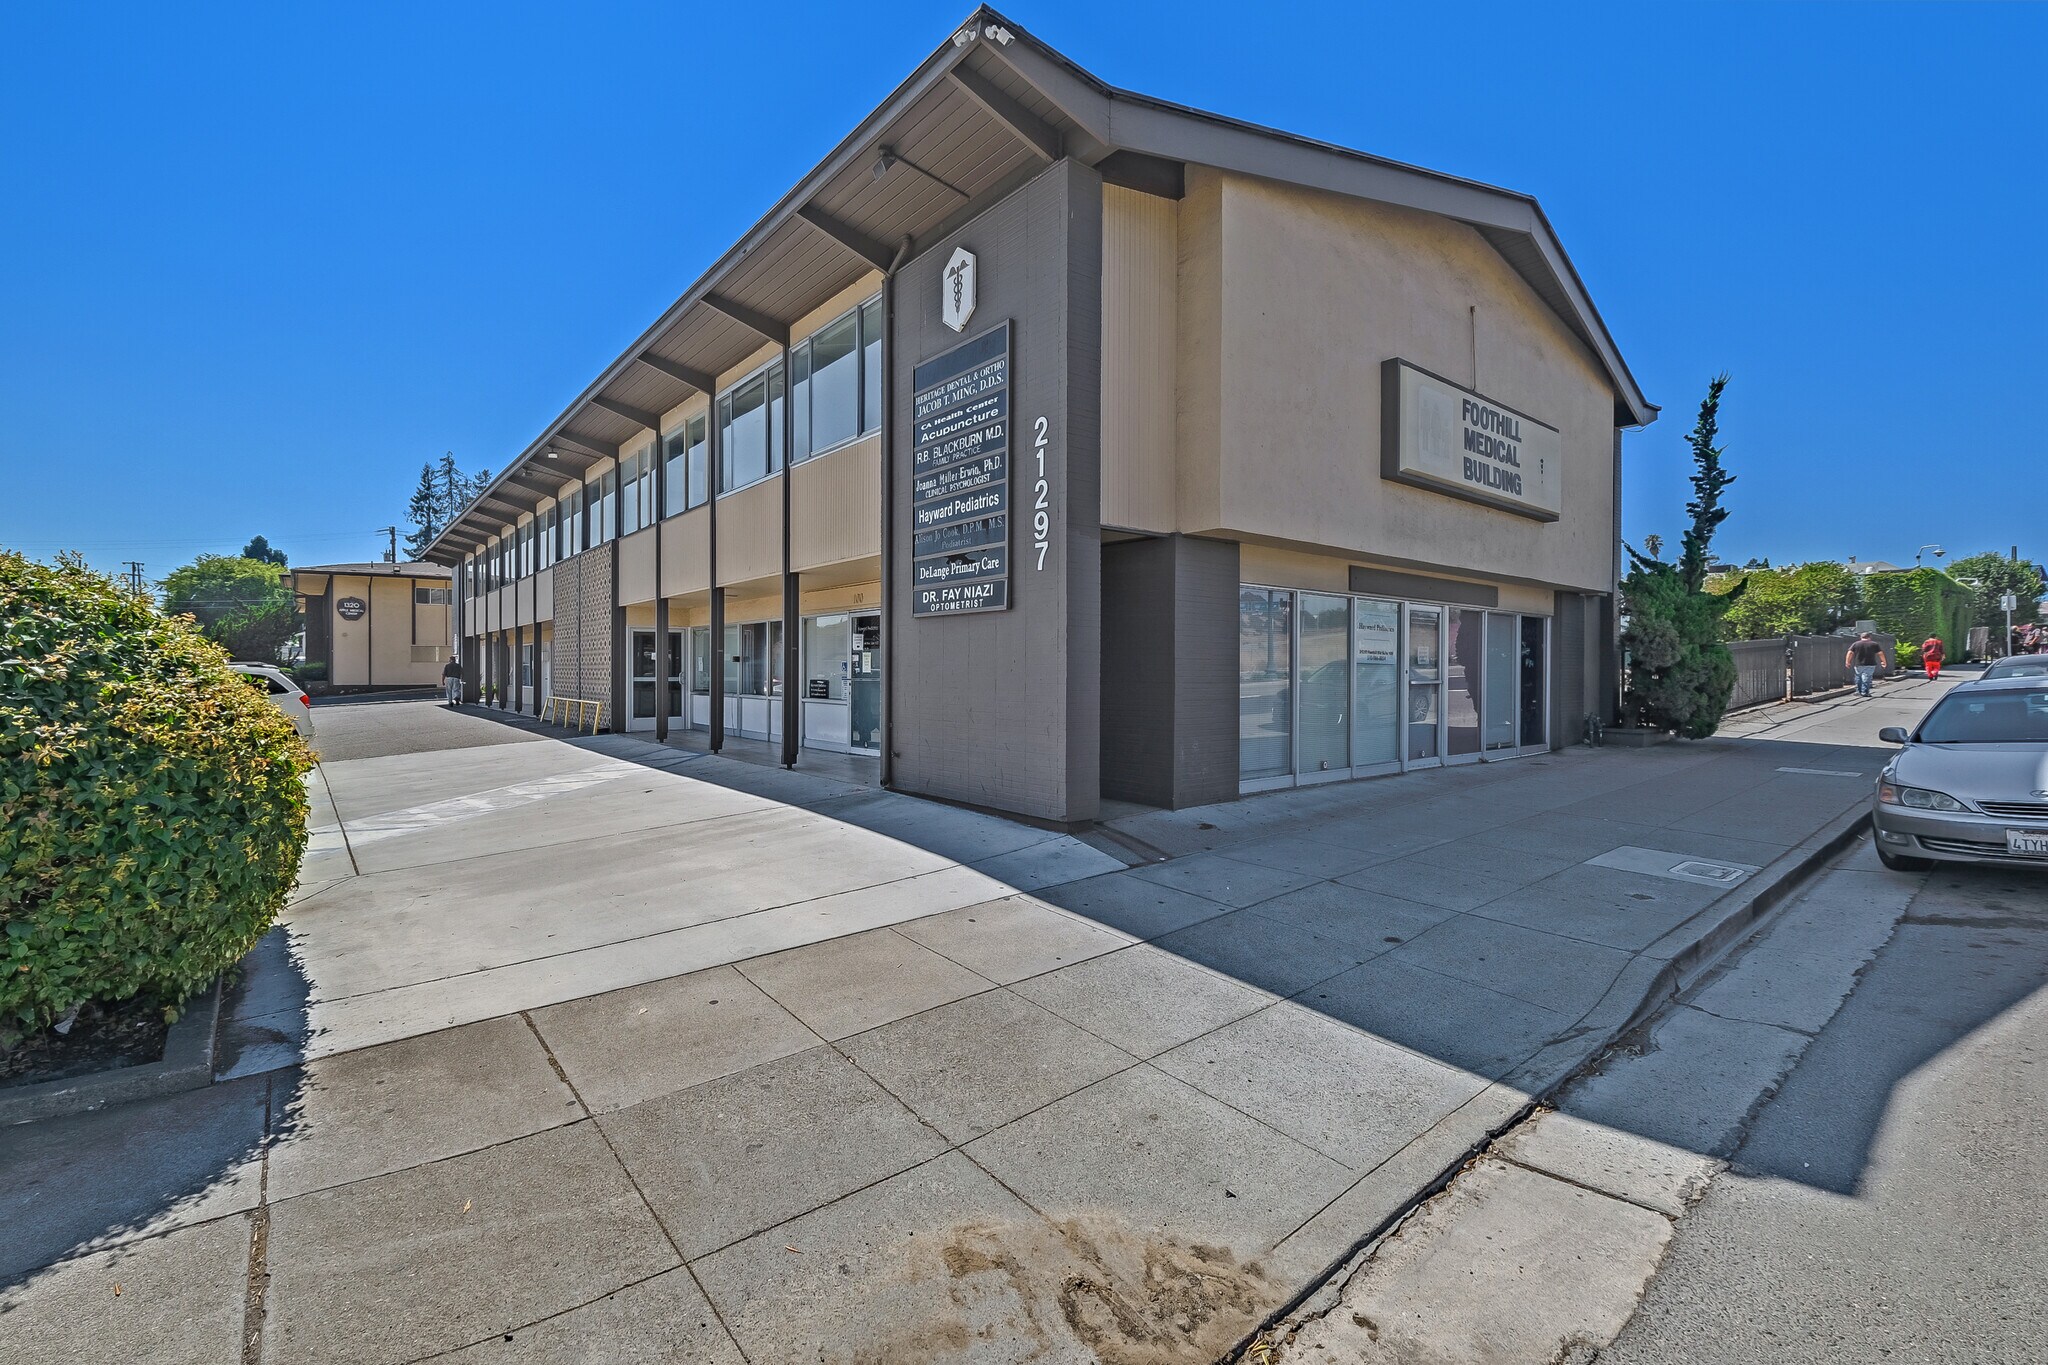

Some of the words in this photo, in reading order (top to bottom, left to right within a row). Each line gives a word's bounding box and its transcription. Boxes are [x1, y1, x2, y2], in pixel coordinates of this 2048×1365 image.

[915, 386, 945, 405] HERITAGE
[947, 375, 972, 392] DENTAL
[973, 371, 979, 381] &
[980, 360, 1005, 377] ORTHO
[918, 398, 942, 417] JACOB
[943, 395, 950, 406] T.
[952, 384, 977, 403] MING,
[980, 372, 1004, 391] D.D.S.
[921, 408, 999, 443] Acupuncture
[934, 410, 963, 424] Health
[966, 396, 999, 413] Center
[1462, 398, 1522, 443] FOOTHILL
[932, 455, 950, 467] FAMILY
[952, 444, 982, 460] PRACTICE
[933, 431, 983, 459] BLACKBURN
[985, 425, 1004, 441] M.D.
[1463, 427, 1520, 468] MEDICAL
[916, 479, 937, 492] Joanna
[983, 456, 1003, 472] Ph.D.
[925, 486, 947, 498] CLINICAL
[949, 473, 991, 492] PSYCHOLOGIST
[1463, 456, 1522, 496] BUILDING
[918, 502, 953, 524] Hayward
[955, 493, 1000, 515] Pediatrics
[1034, 416, 1049, 571] 21297
[920, 564, 950, 580] DeLange
[951, 561, 980, 575] Primary
[981, 557, 1000, 570] Care
[922, 591, 939, 603] DR.
[942, 587, 961, 601] FAY
[964, 583, 994, 598] NIAZI
[930, 599, 984, 612] OPTOMETRIST
